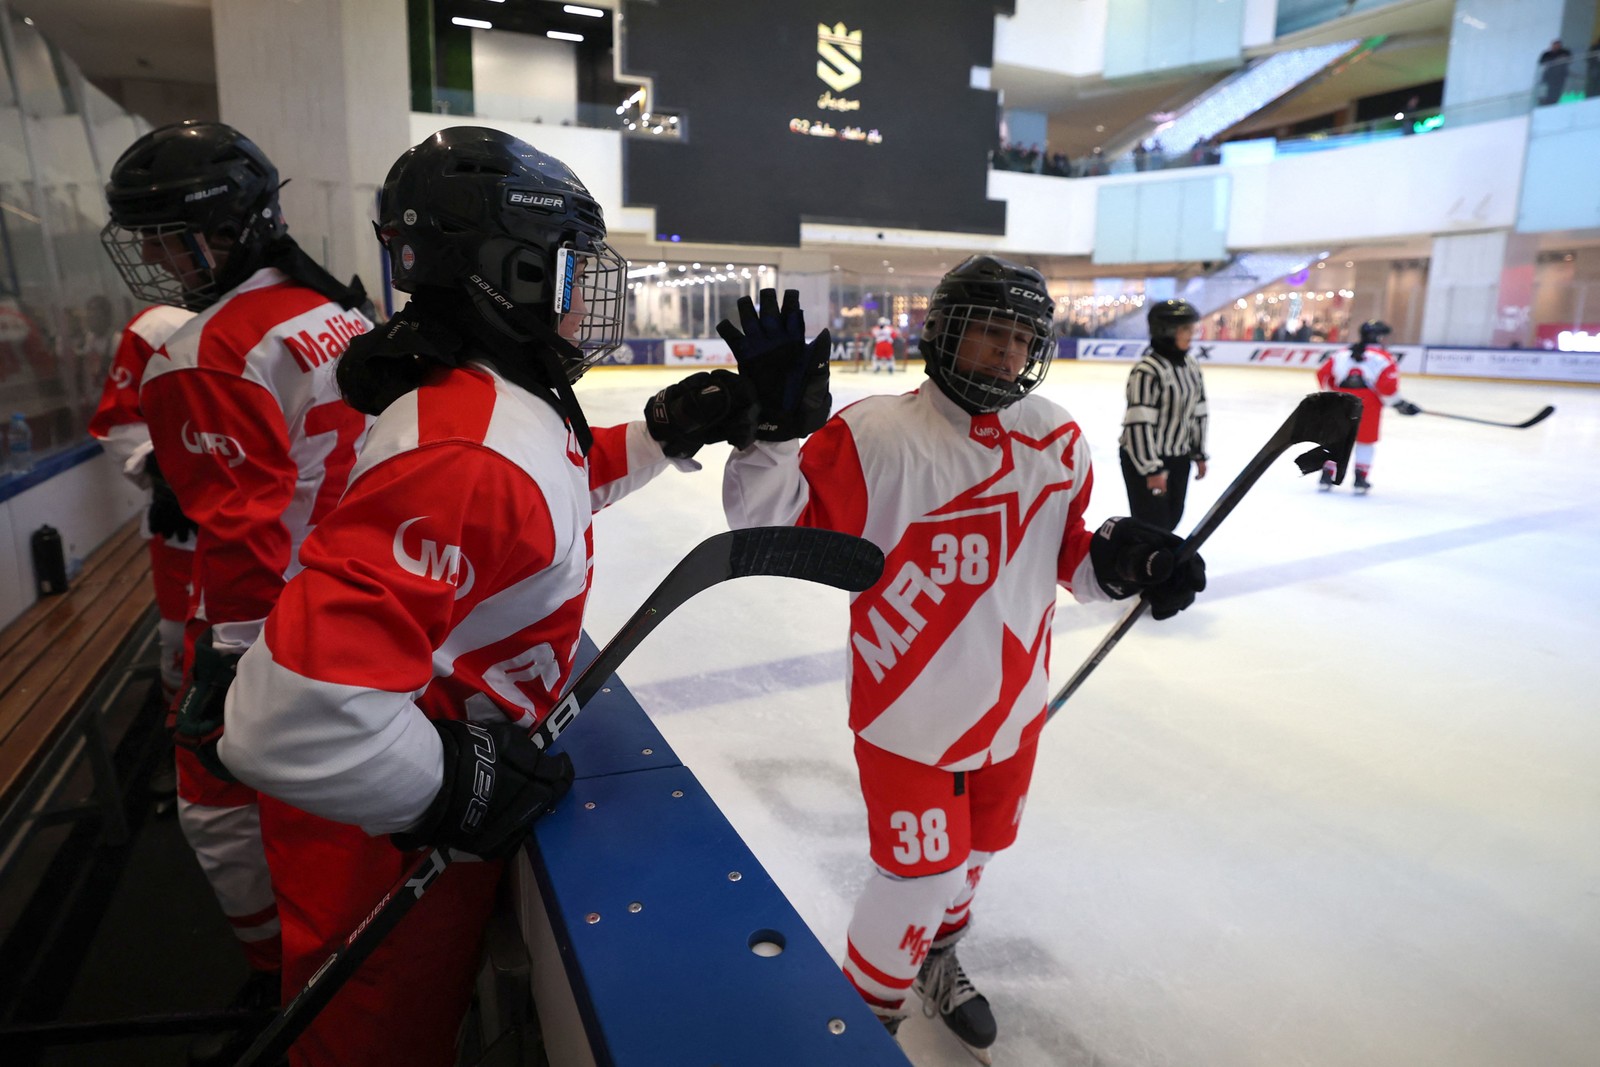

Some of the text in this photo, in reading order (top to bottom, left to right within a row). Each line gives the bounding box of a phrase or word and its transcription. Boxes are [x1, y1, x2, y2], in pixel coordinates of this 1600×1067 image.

[510, 194, 563, 208] BAUER
[469, 274, 514, 310] BAUER
[563, 255, 574, 310] BAUER
[1010, 287, 1045, 303] CCM
[930, 533, 989, 585] 38
[890, 808, 950, 865] 38
